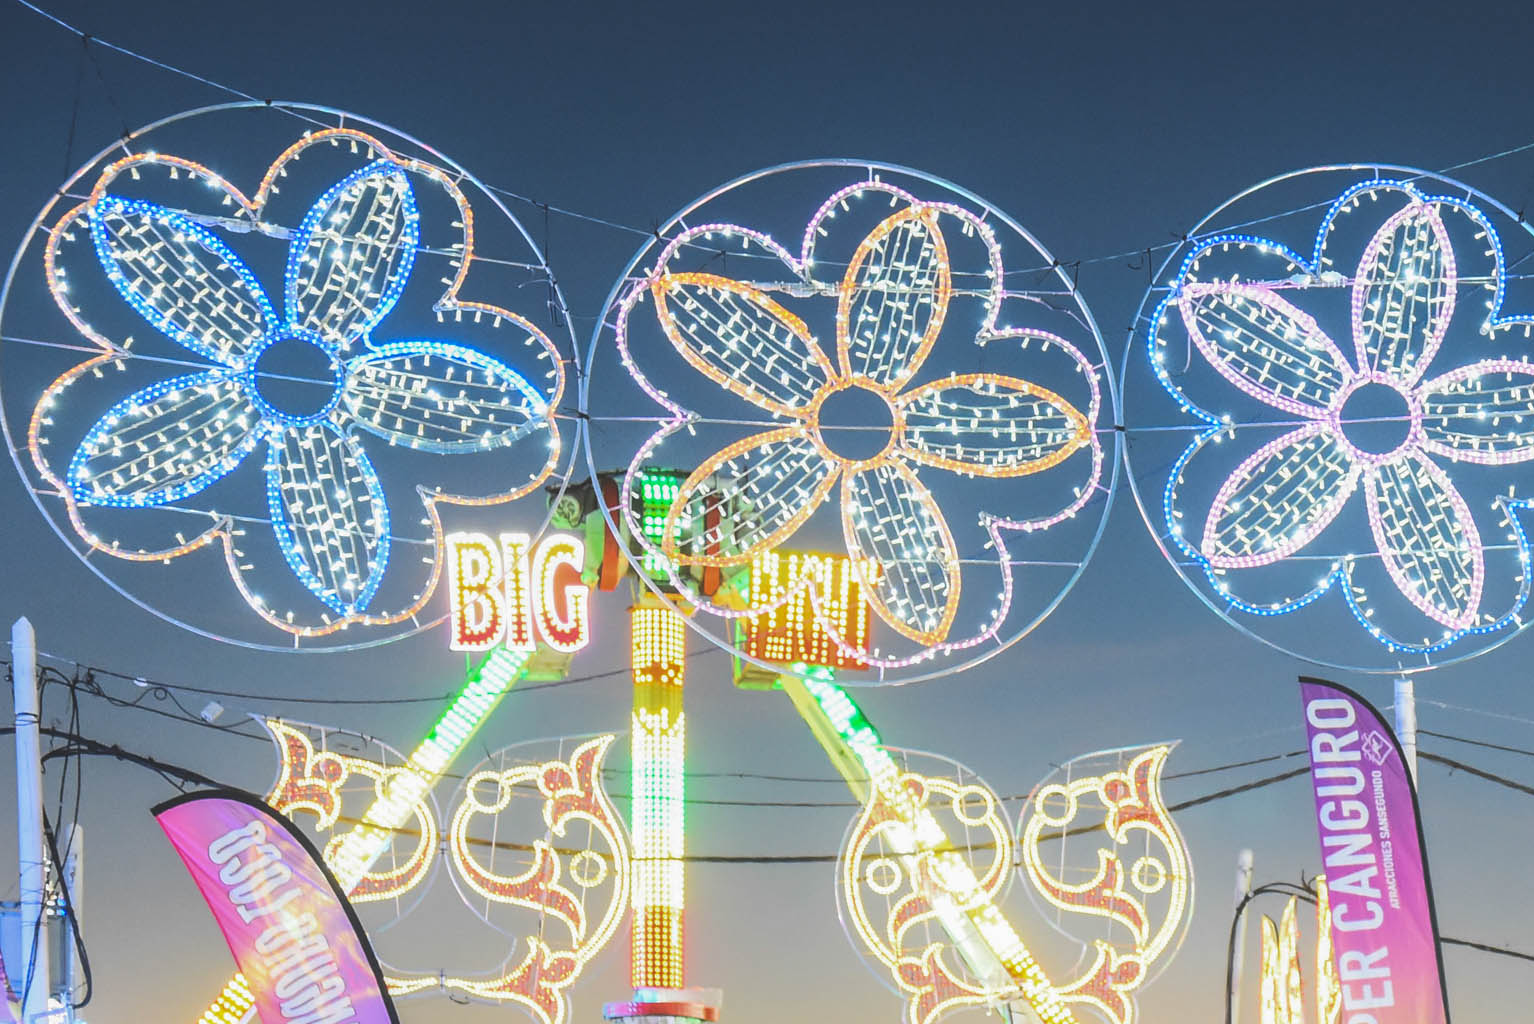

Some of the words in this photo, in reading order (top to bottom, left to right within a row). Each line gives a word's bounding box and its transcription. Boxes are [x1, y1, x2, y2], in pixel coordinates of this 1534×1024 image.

[445, 532, 590, 652] BIG
[1306, 698, 1384, 933] CANGURO
[1373, 770, 1390, 840] SANSEGUNDO
[1379, 841, 1401, 909] ATRACCIONES
